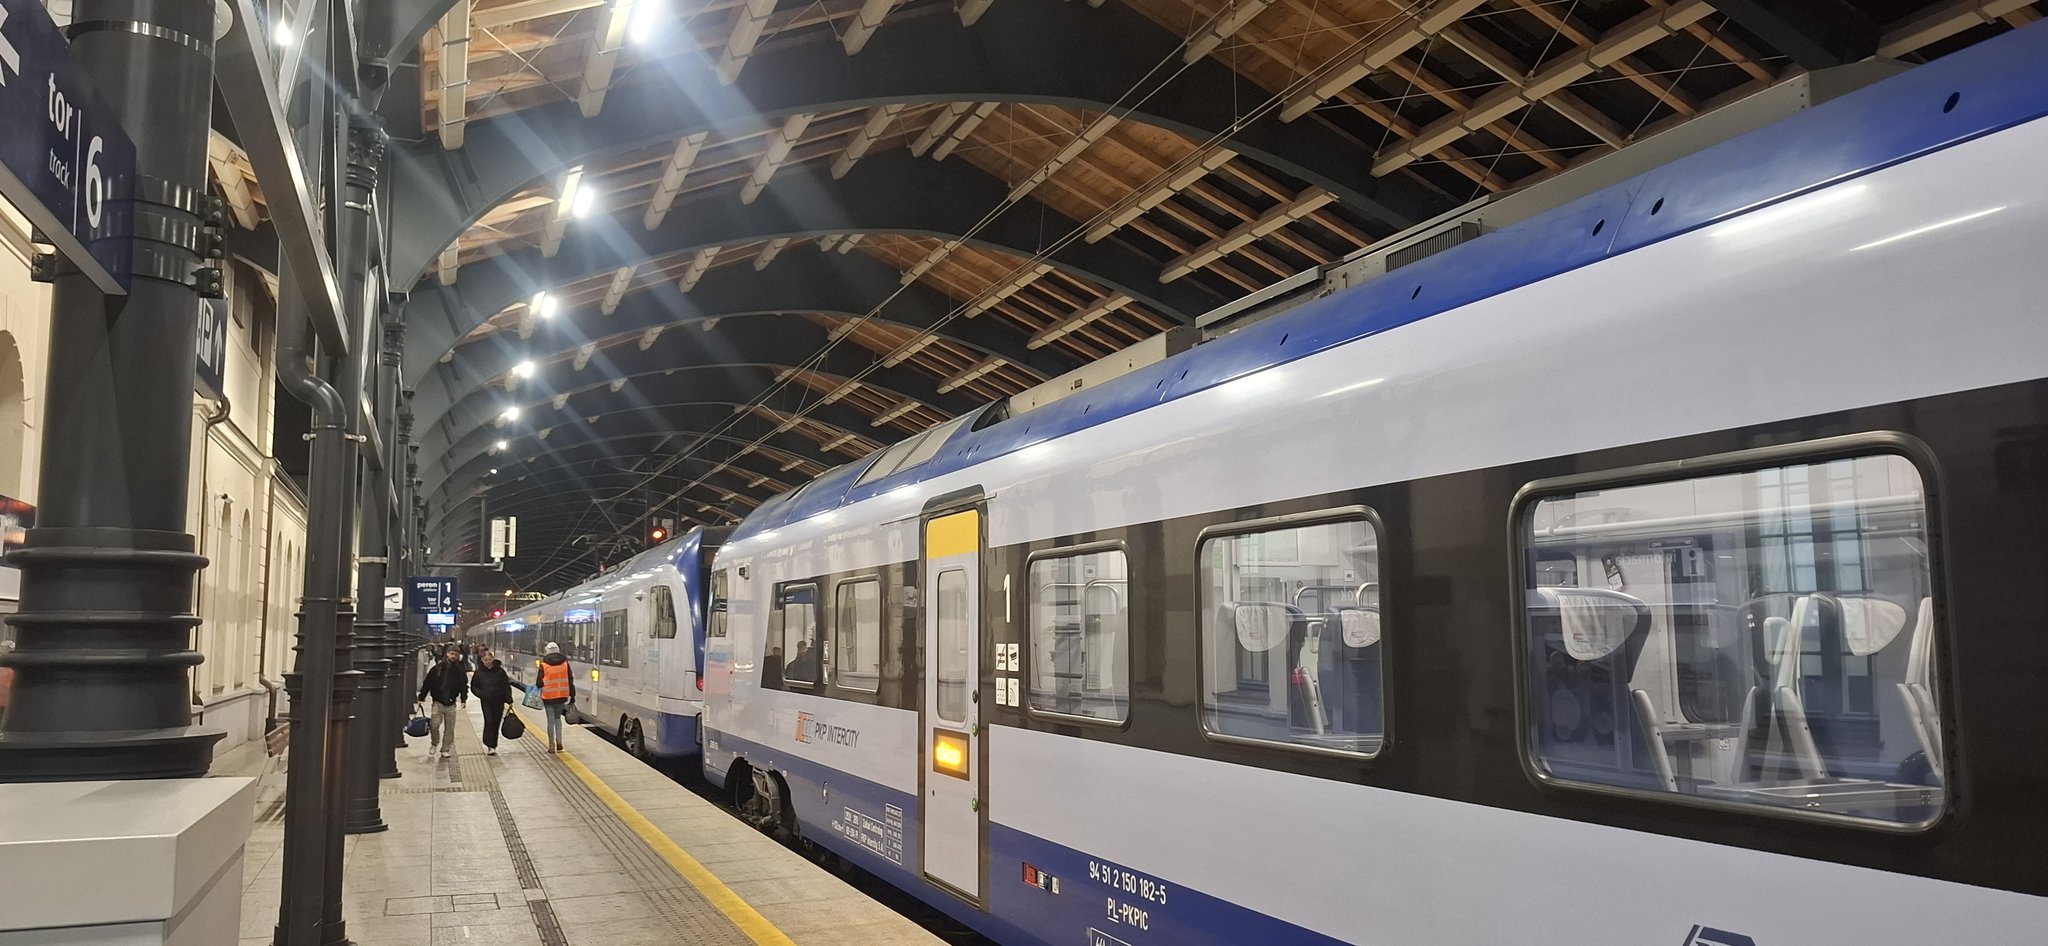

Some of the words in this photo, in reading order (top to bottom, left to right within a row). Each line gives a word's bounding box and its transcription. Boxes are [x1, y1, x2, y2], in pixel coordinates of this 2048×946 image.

[49, 72, 73, 140] tor
[86, 135, 103, 229] 6
[49, 148, 71, 190] track
[443, 596, 451, 606] 4
[445, 582, 451, 593] 1
[1003, 573, 1011, 623] 1
[814, 722, 828, 740] PKP
[827, 725, 860, 748] INTERCITY
[1089, 860, 1100, 881] 94
[1102, 864, 1111, 885] 51
[1113, 869, 1120, 888] 2
[1121, 871, 1137, 894] 150
[1139, 877, 1167, 905] 182-5
[1107, 897, 1149, 931] PL-PKPIC
